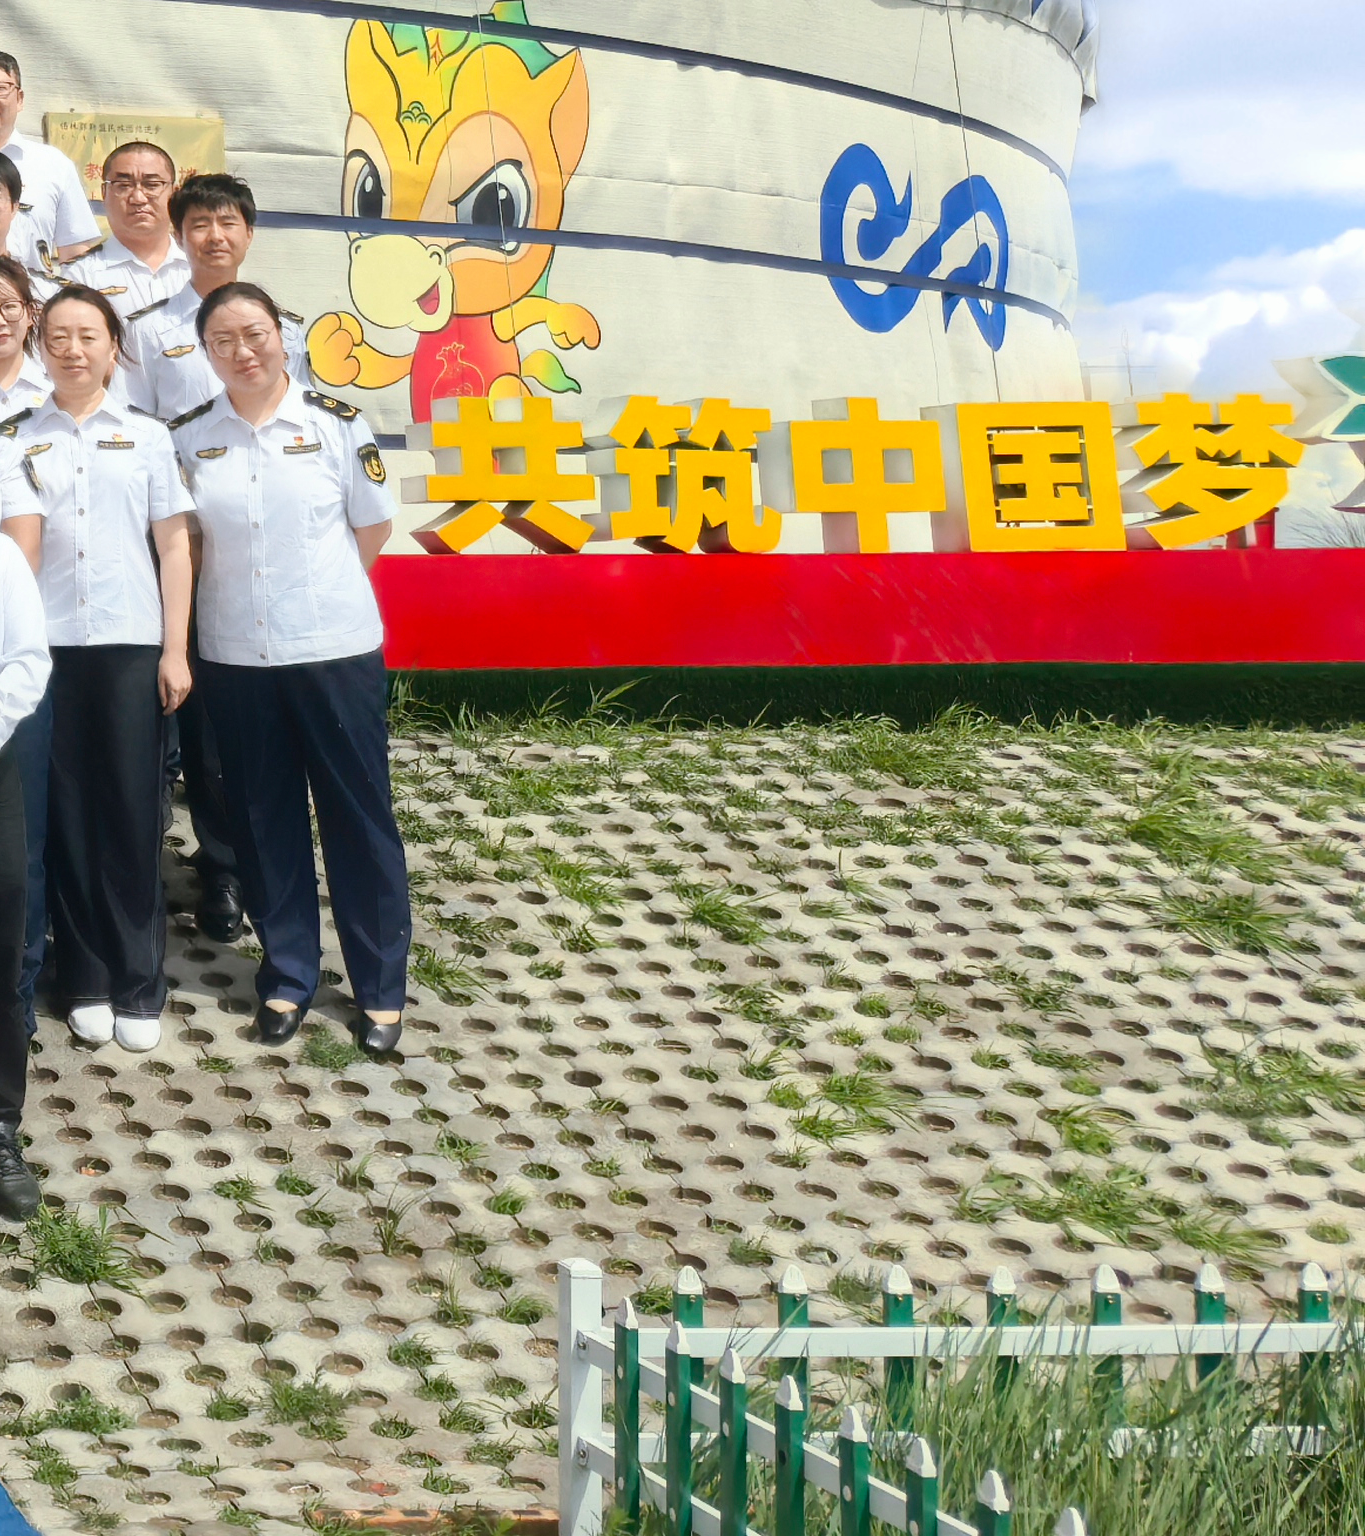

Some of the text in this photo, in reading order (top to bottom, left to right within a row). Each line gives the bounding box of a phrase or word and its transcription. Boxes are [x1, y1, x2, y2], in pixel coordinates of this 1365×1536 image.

[409, 393, 1305, 555] 共筑中国梦
